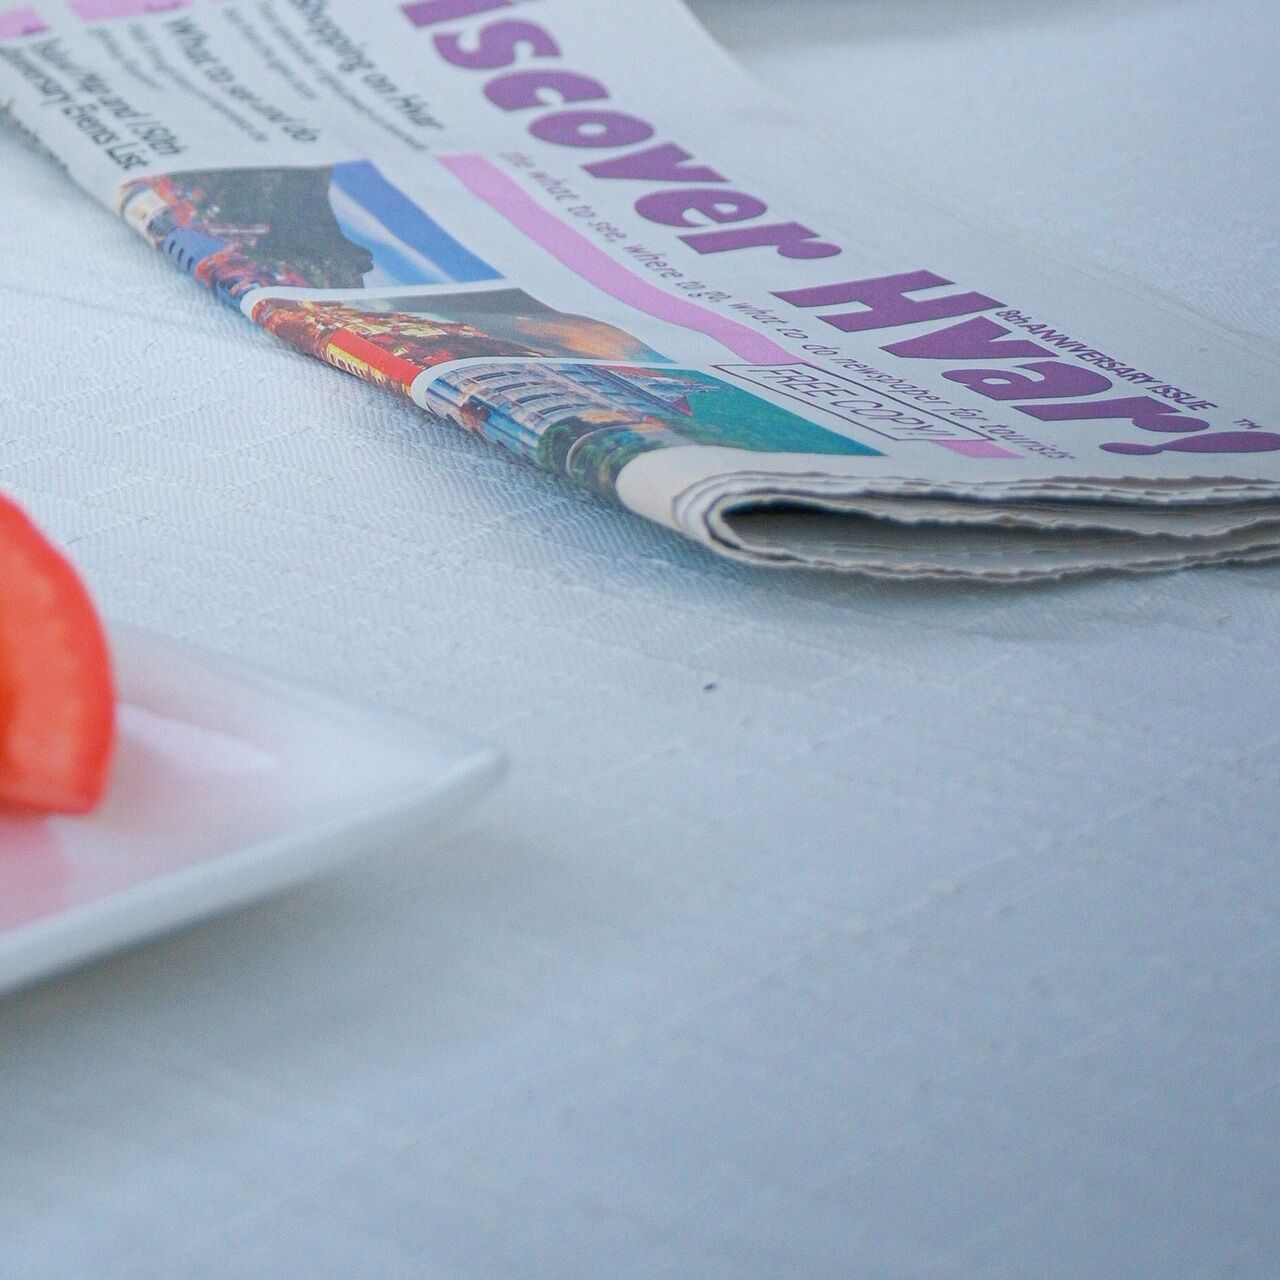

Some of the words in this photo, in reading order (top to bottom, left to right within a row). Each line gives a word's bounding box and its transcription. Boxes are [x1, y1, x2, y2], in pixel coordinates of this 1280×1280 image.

[162, 16, 219, 67] What
[204, 55, 235, 83] to
[362, 70, 399, 96] on
[60, 103, 122, 146] Events
[105, 141, 150, 171] List
[528, 169, 580, 202] what
[567, 203, 598, 220] to
[622, 242, 684, 280] where
[674, 279, 706, 291] to
[727, 300, 785, 325] what
[776, 326, 809, 340] to
[801, 343, 841, 358] do
[830, 355, 951, 406] newspaper
[931, 406, 989, 423] for
[979, 422, 1077, 461] tourists
[994, 308, 1033, 328] 8th
[1024, 322, 1164, 385] ANNIVERSARY
[1144, 380, 1219, 412] ISSUE
[747, 368, 860, 398] FREE
[829, 398, 957, 437] COPY!
[1232, 416, 1263, 430] TM
